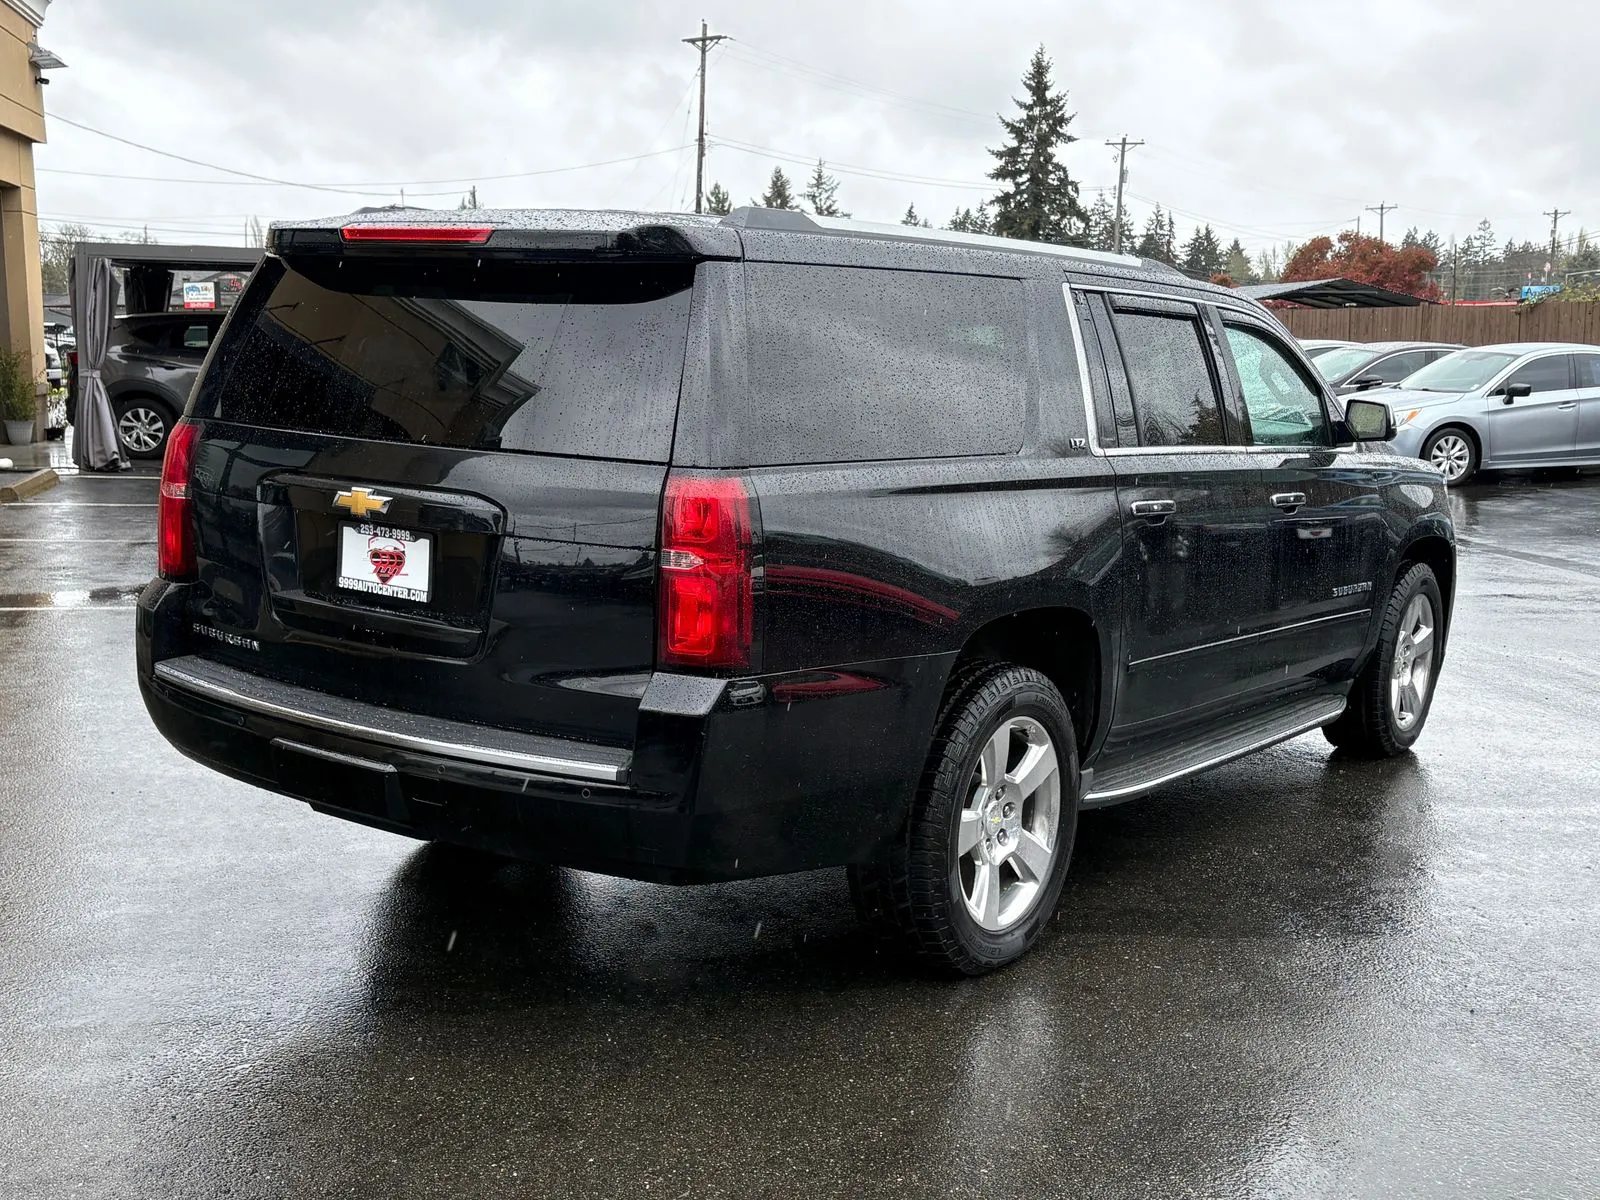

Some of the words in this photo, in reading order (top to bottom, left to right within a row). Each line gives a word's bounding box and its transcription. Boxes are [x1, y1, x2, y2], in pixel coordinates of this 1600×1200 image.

[360, 523, 411, 541] 253-473-9999
[338, 576, 428, 603] 9999AUTOCENTER.COM
[1332, 581, 1373, 597] SUBURBAN
[192, 622, 261, 652] SUBURBAN
